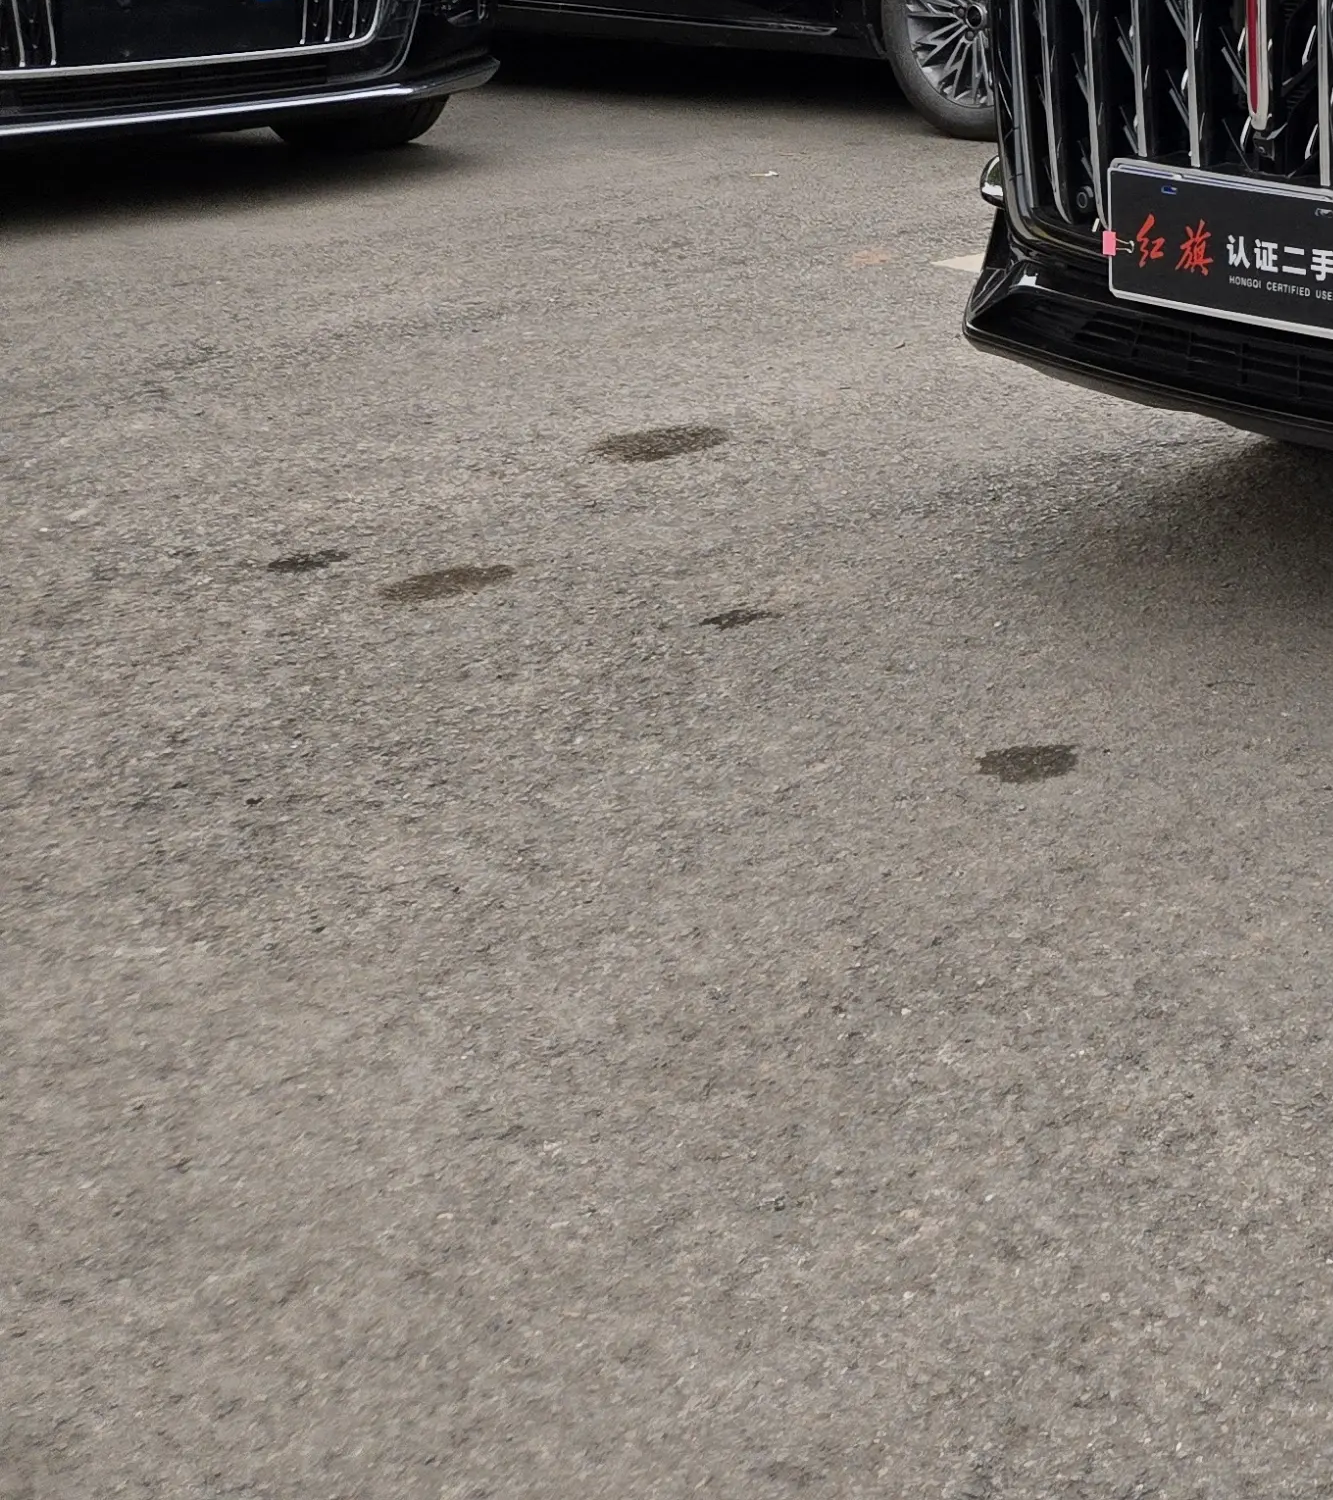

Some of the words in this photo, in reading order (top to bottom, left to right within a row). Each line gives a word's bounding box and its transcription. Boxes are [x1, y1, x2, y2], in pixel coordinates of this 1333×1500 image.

[1136, 212, 1214, 277] 红旗
[1229, 276, 1263, 290] HONGQI
[1266, 280, 1311, 298] CERTIFIED
